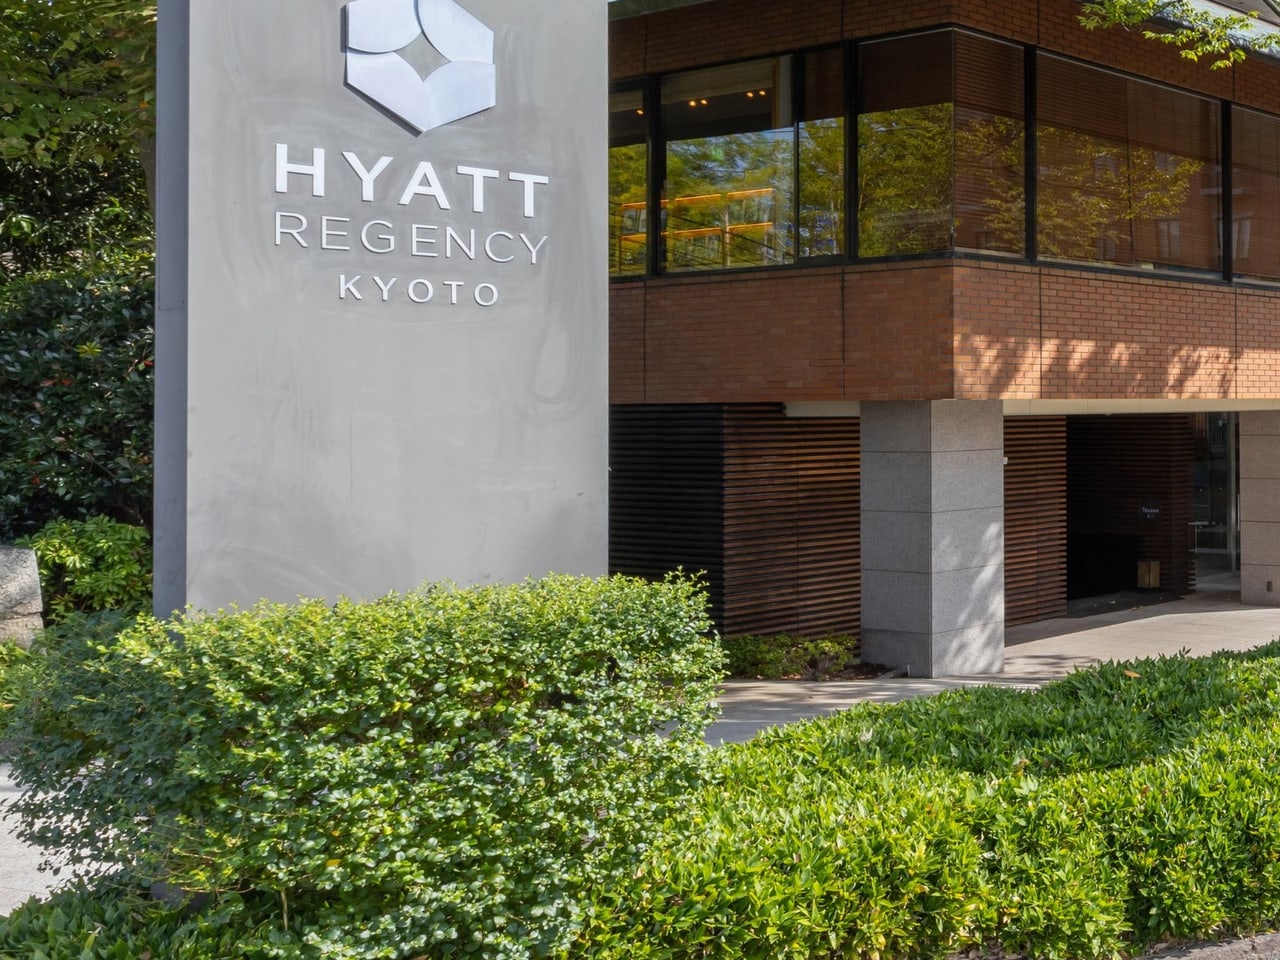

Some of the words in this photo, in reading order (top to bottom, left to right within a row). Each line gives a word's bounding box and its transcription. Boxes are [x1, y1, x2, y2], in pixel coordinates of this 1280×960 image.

[274, 143, 549, 218] HYATT
[273, 211, 549, 265] REGENCY
[338, 274, 499, 307] KYOTO
